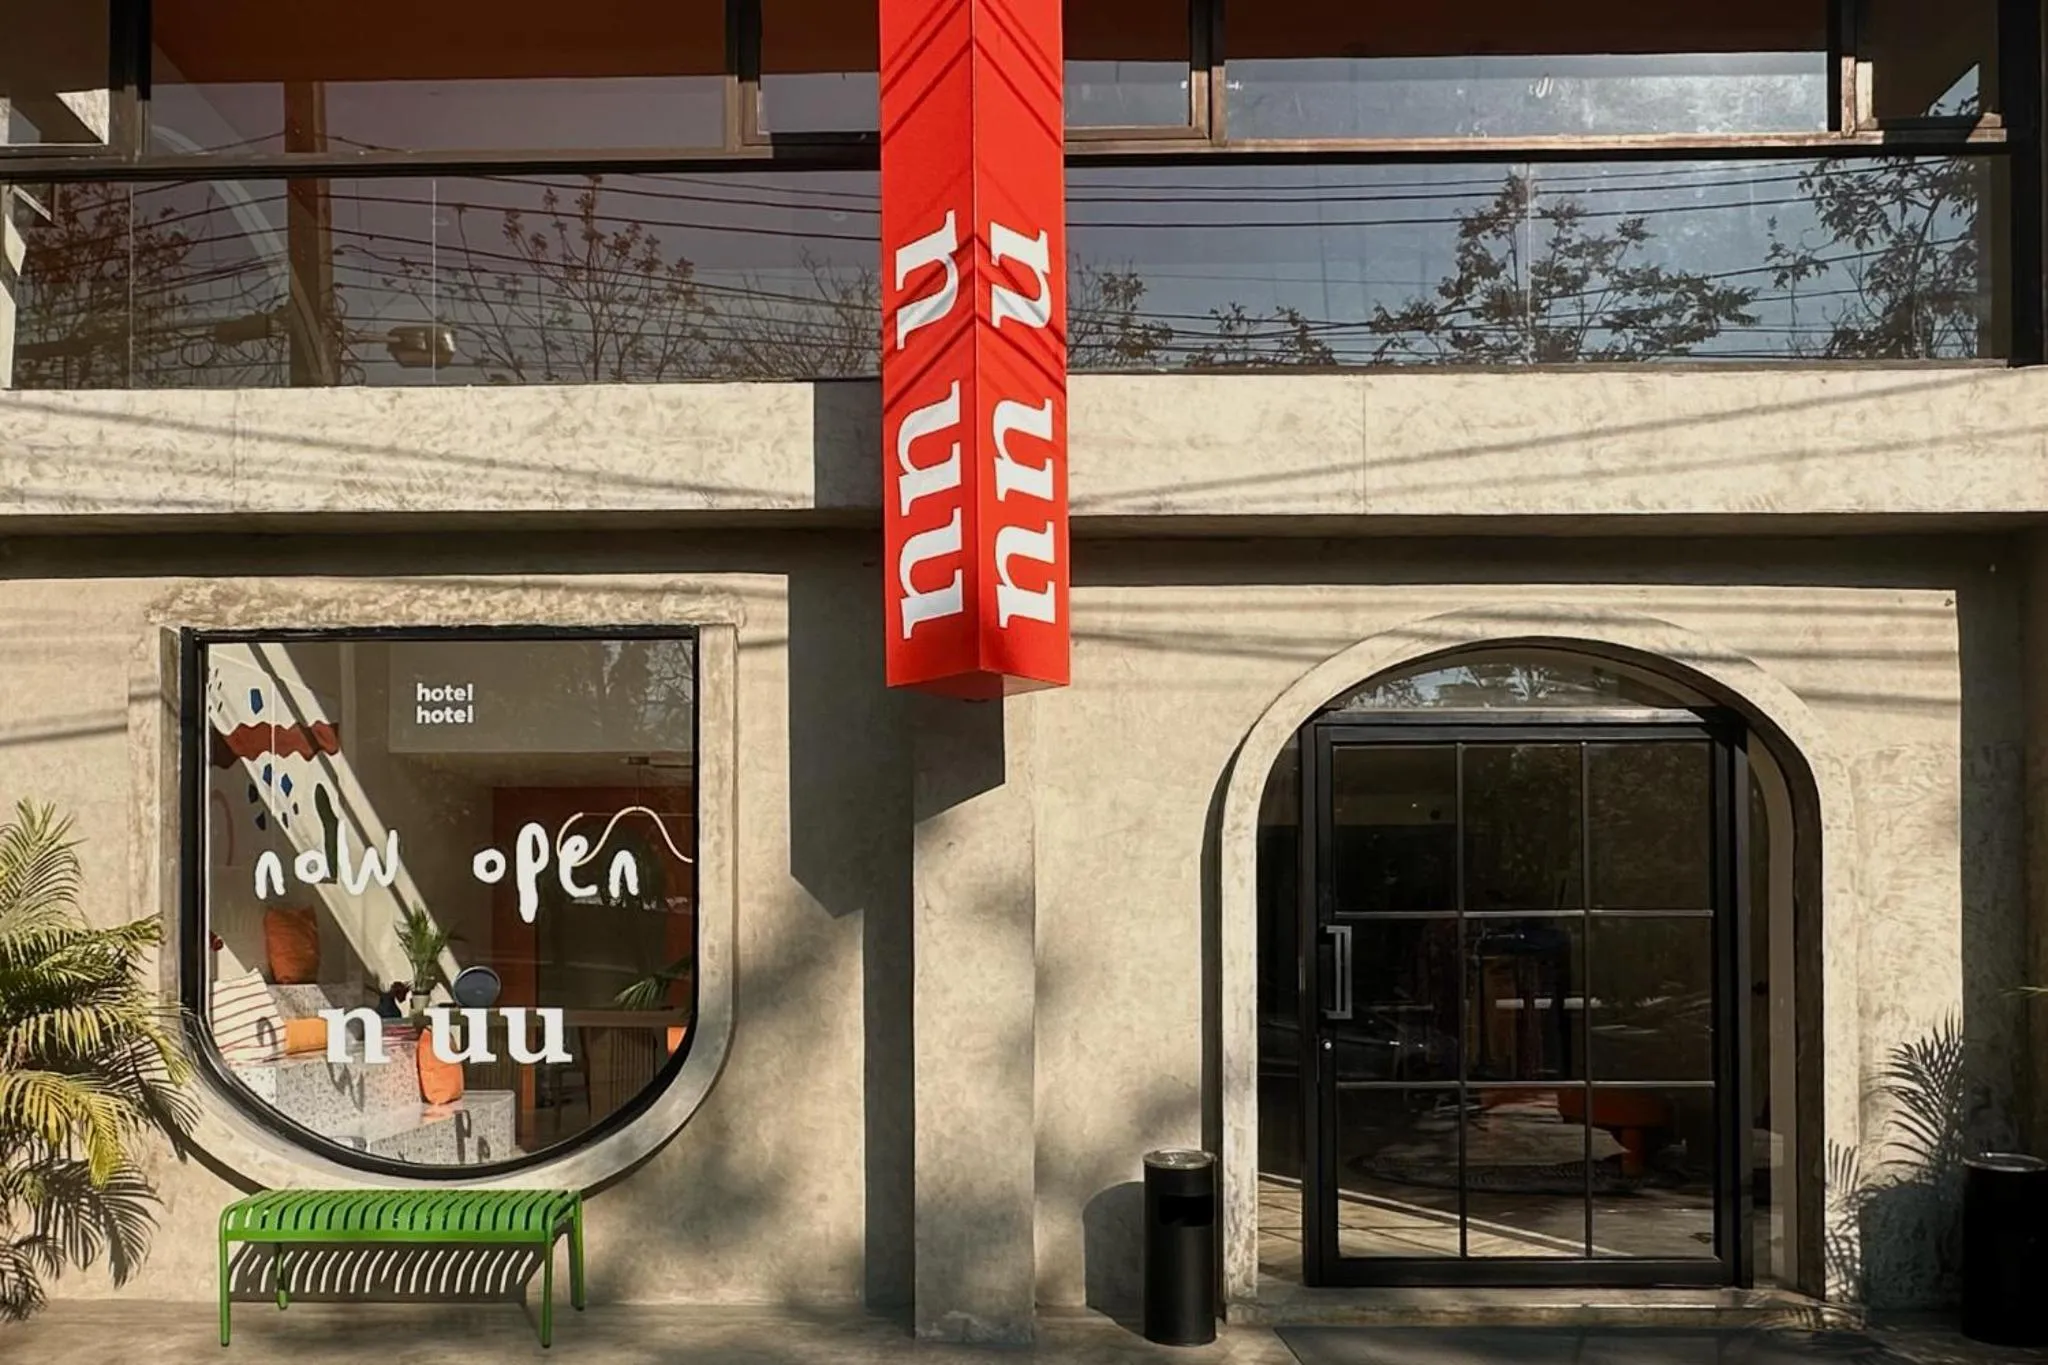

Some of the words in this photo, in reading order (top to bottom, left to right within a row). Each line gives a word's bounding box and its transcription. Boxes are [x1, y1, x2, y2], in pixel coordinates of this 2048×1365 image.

[416, 682, 474, 702] hotel
[416, 704, 474, 724] hotel
[255, 818, 399, 899] now
[473, 822, 639, 923] open
